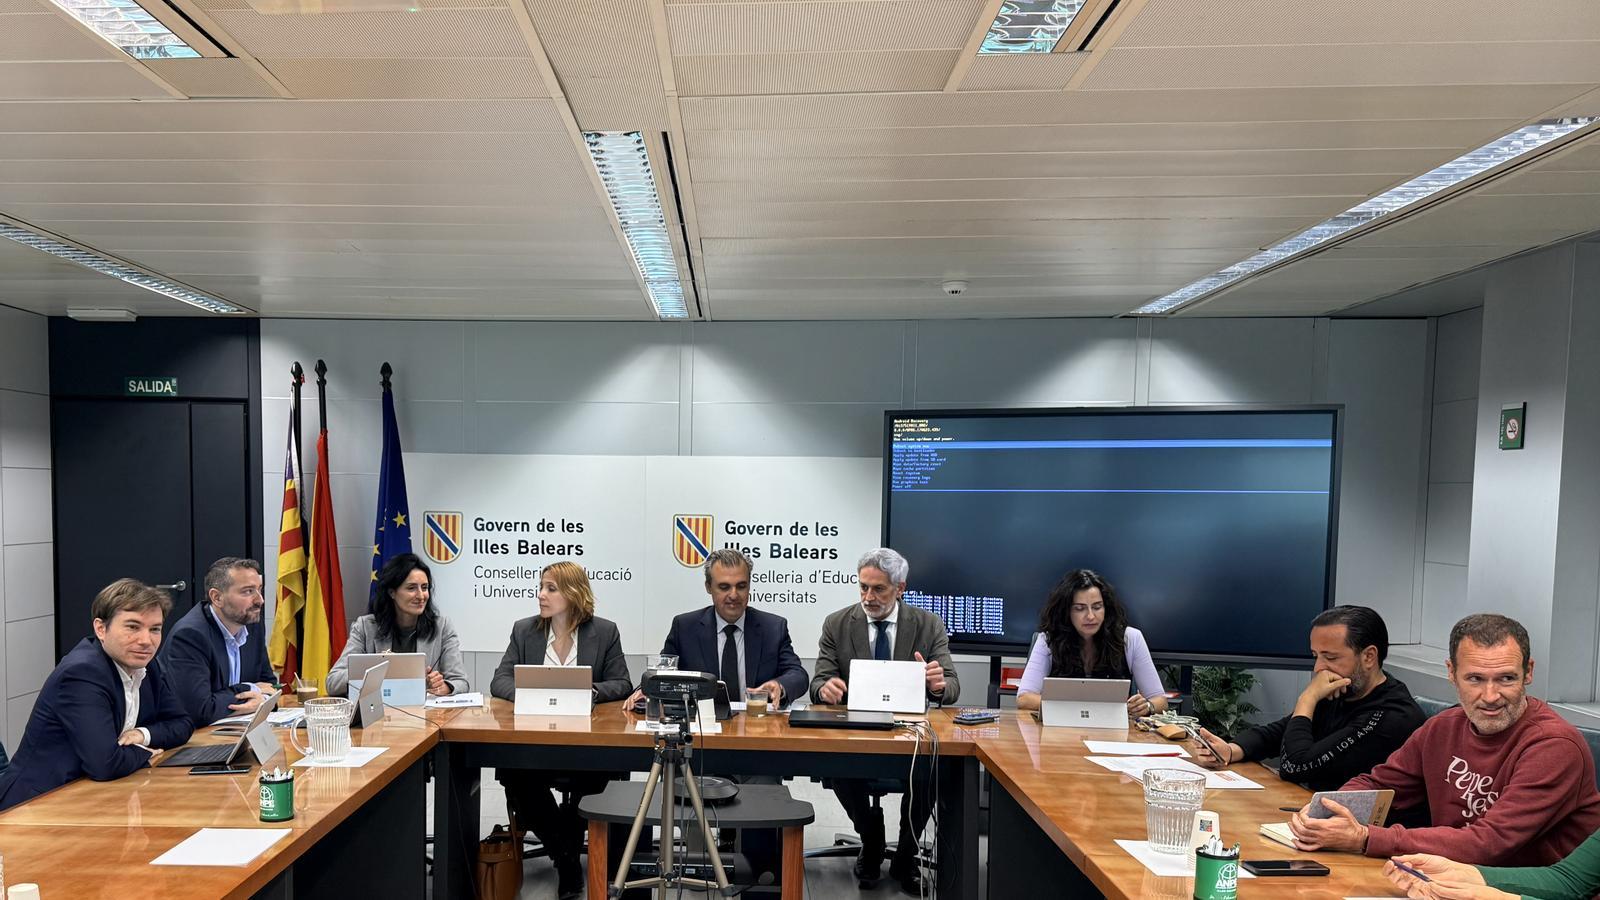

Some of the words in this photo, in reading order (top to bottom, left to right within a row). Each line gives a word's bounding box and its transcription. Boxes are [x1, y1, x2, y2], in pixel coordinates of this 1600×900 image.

[128, 380, 173, 393] SALIDA
[473, 518, 530, 534] Govern
[537, 518, 556, 534] de
[561, 518, 585, 534] les
[725, 520, 783, 537] Govern
[789, 521, 809, 537] de
[815, 521, 839, 538] les
[473, 538, 510, 555] Illes
[517, 539, 584, 556] Balears
[769, 542, 839, 560] Balears
[473, 565, 542, 579] Conselleri
[751, 569, 803, 584] selleria
[474, 585, 477, 598] i
[482, 585, 539, 598] Universi
[1336, 737, 1355, 751] LOS
[1444, 755, 1493, 800] Pepe
